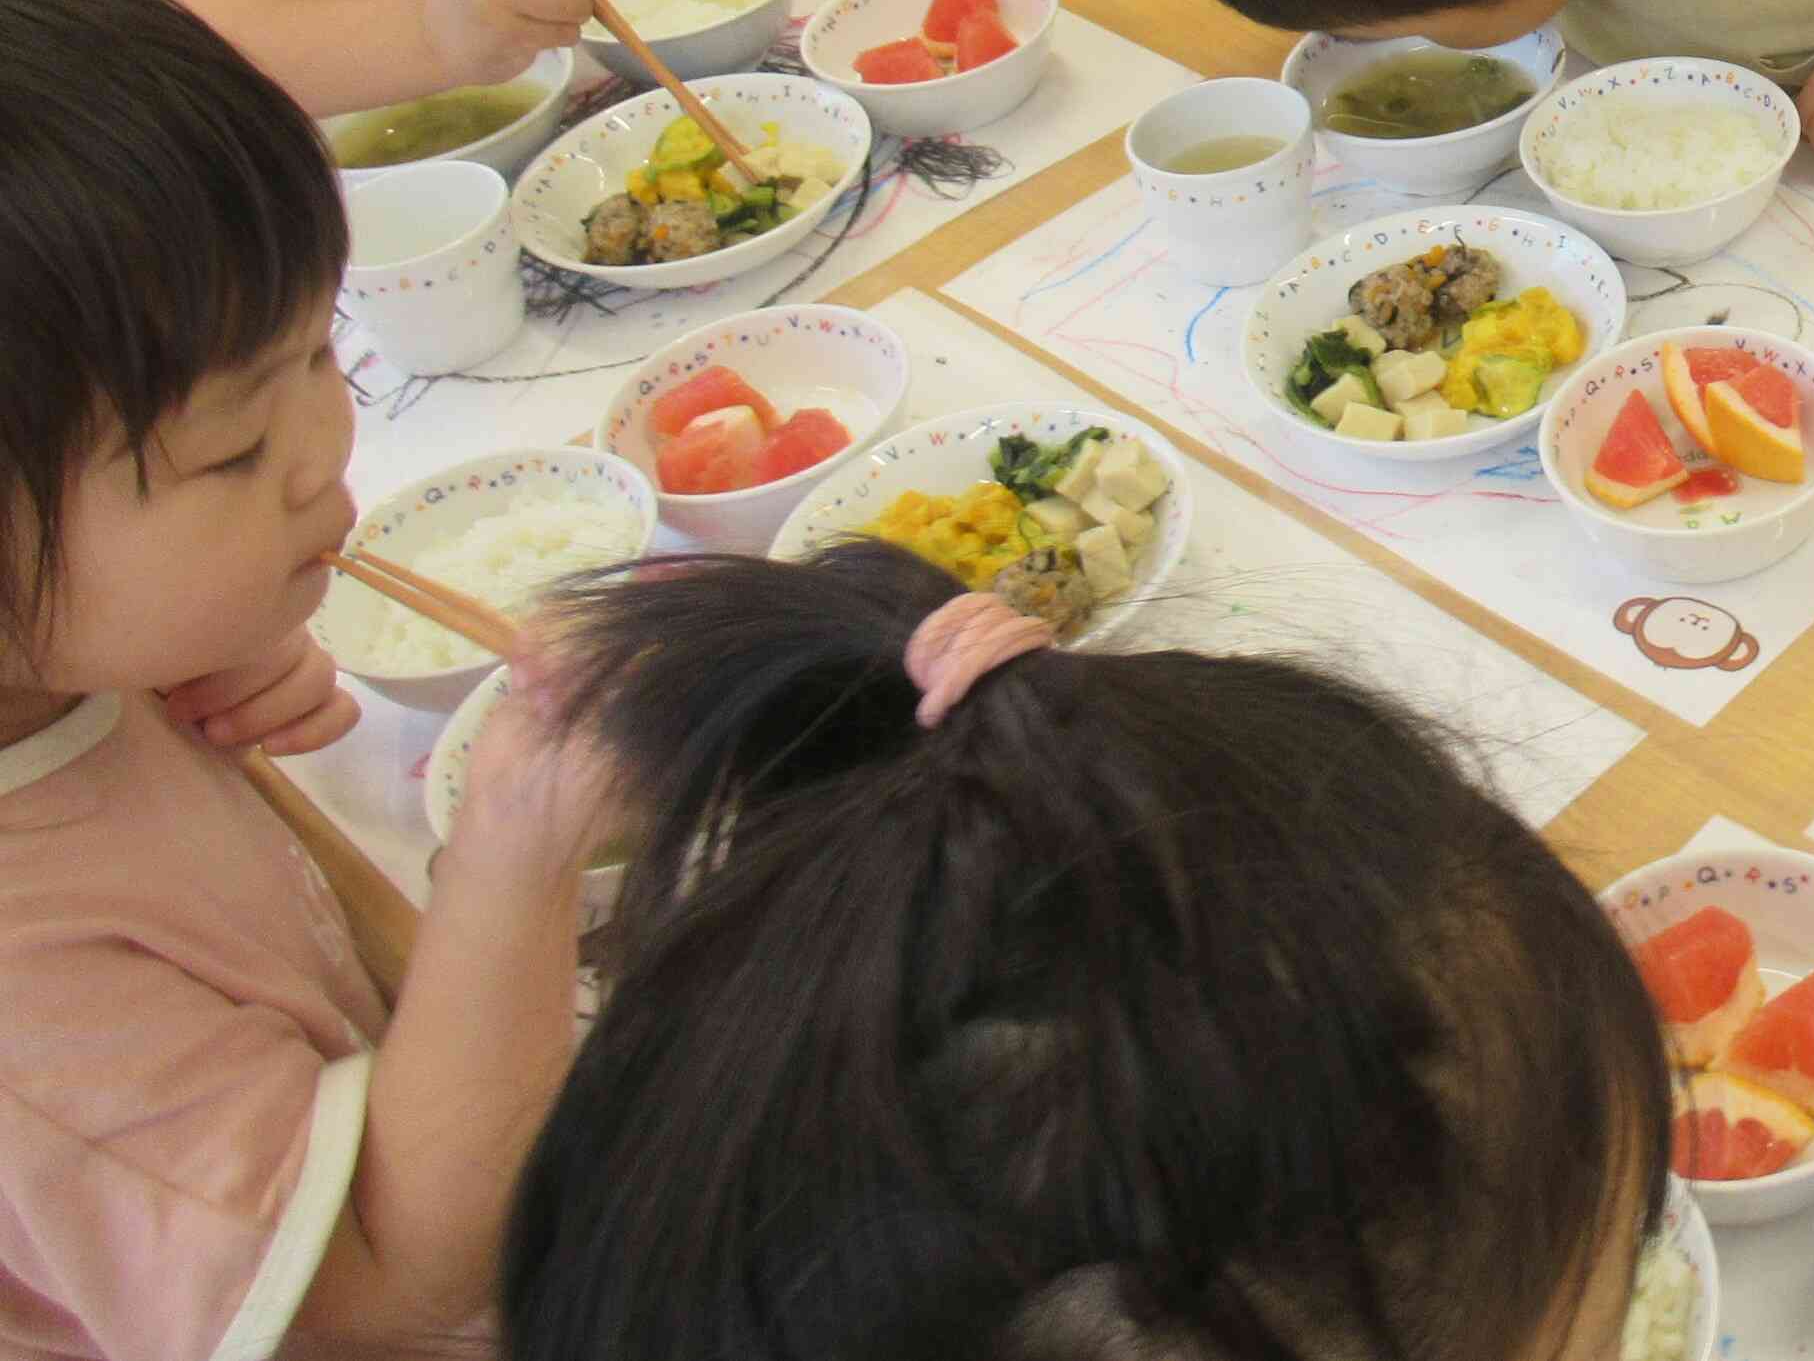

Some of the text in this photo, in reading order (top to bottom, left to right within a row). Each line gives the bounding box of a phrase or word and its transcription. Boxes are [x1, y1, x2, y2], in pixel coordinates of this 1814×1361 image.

[1608, 77, 1619, 88] X
[1665, 68, 1674, 79] Z
[1702, 74, 1710, 85] A
[1374, 233, 1388, 245] D
[1418, 220, 1429, 233] E
[640, 381, 653, 395] Q
[788, 316, 798, 327] V
[1586, 381, 1600, 395] Q
[1641, 358, 1653, 371] S
[1796, 362, 1807, 374] X
[886, 446, 899, 461] V
[930, 434, 945, 445] W
[425, 488, 444, 504] Q
[469, 475, 480, 489] R
[1698, 866, 1716, 883] Q
[1783, 878, 1797, 894] S
